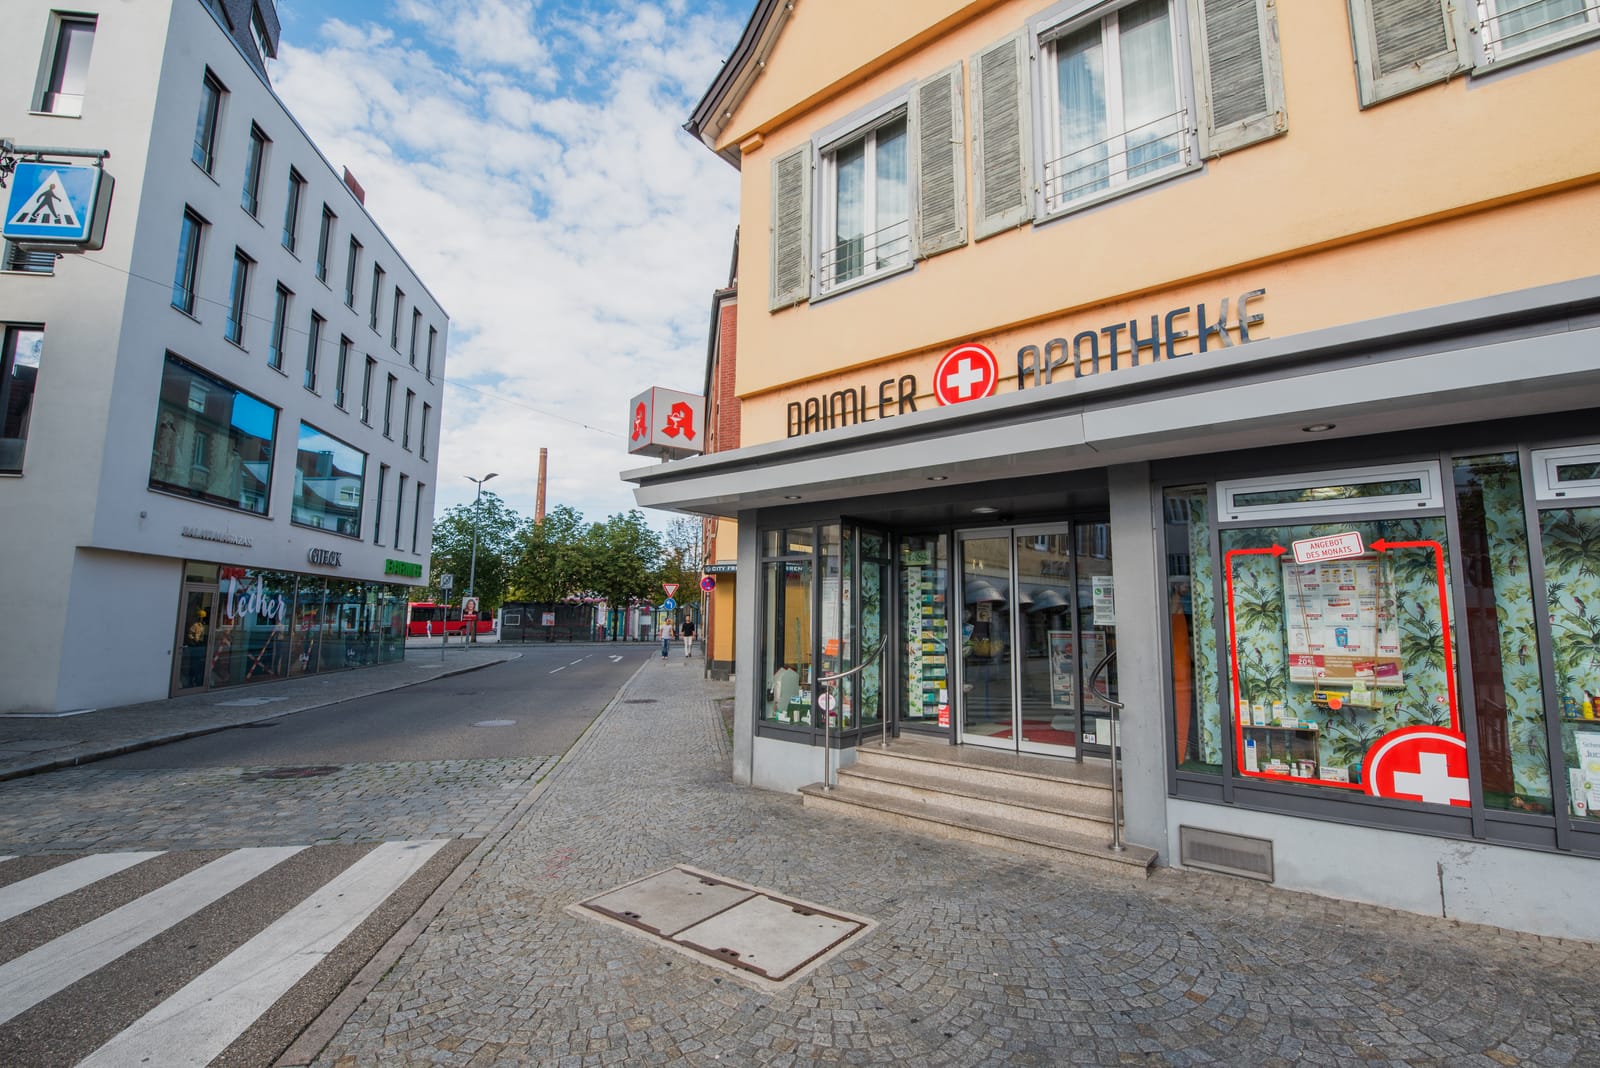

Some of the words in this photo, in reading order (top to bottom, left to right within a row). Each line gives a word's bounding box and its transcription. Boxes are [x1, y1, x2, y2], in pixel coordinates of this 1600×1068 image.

[787, 373, 919, 438] DAIMLER
[1016, 287, 1267, 391] APOTHEKE
[1309, 538, 1344, 550] ANGEBOT
[1305, 551, 1321, 559] DES
[1321, 545, 1353, 558] MONATS
